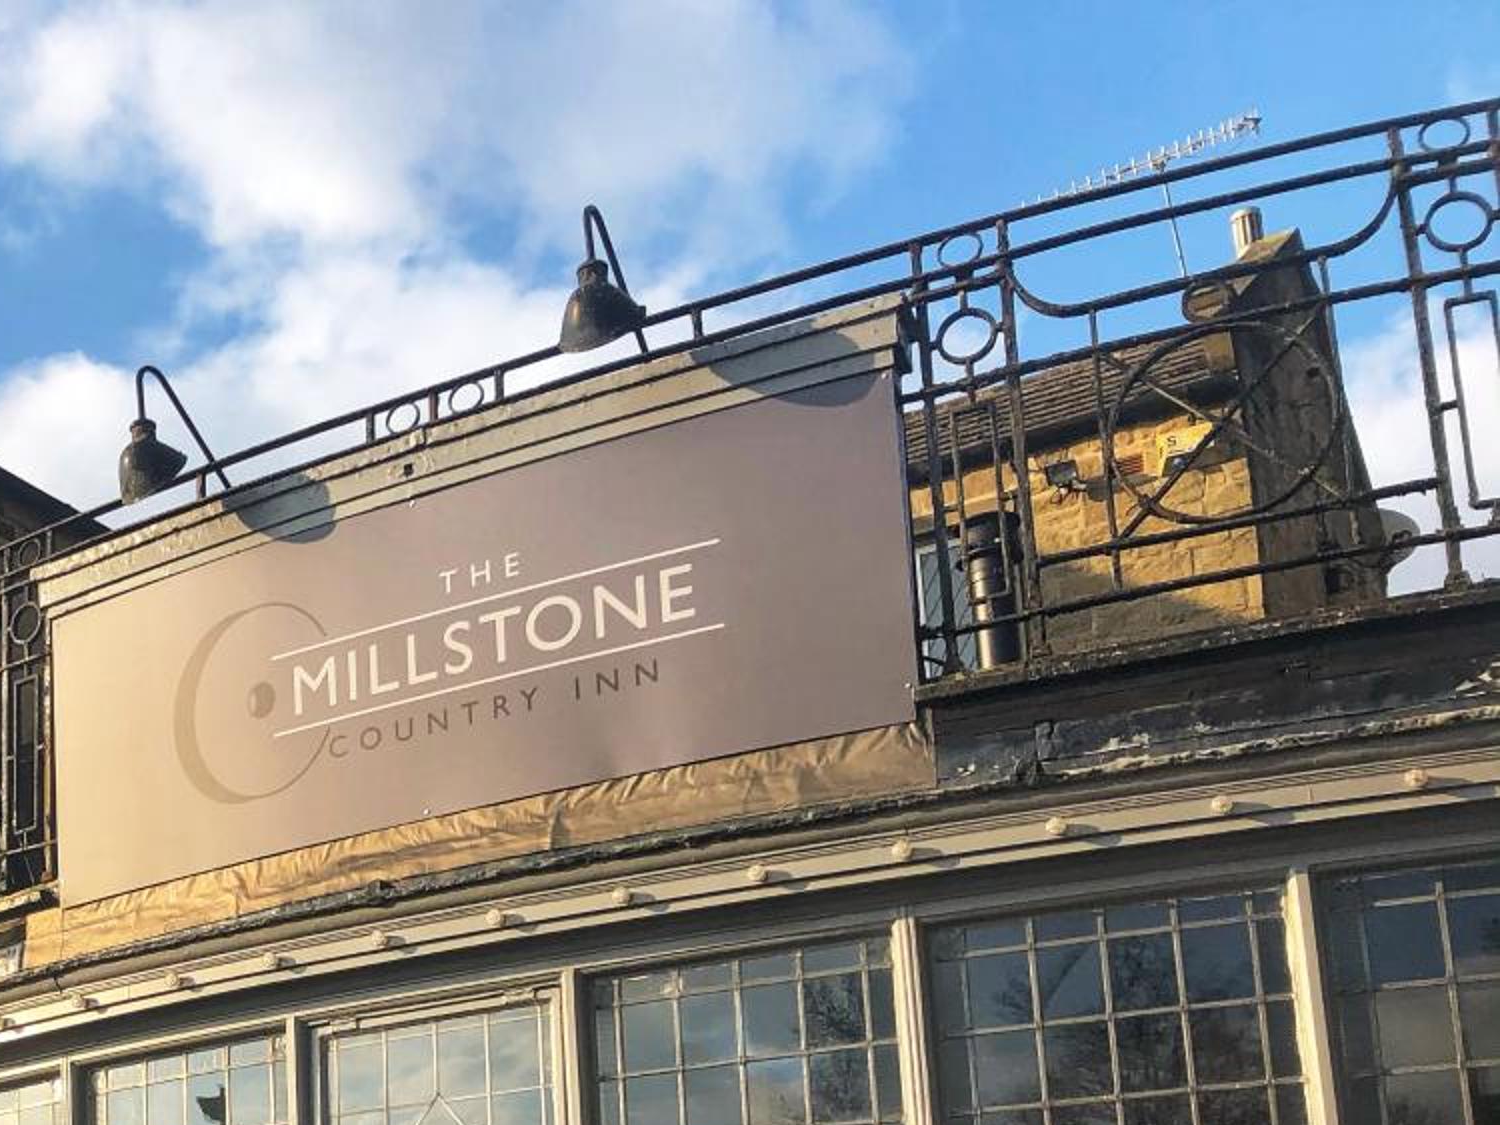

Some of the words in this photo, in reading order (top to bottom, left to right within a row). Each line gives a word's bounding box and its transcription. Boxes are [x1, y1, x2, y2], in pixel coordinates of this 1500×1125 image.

[438, 552, 520, 594] THE
[293, 563, 696, 716] MILLSTONE
[328, 687, 538, 758] COUNTRY
[573, 657, 659, 701] INN
